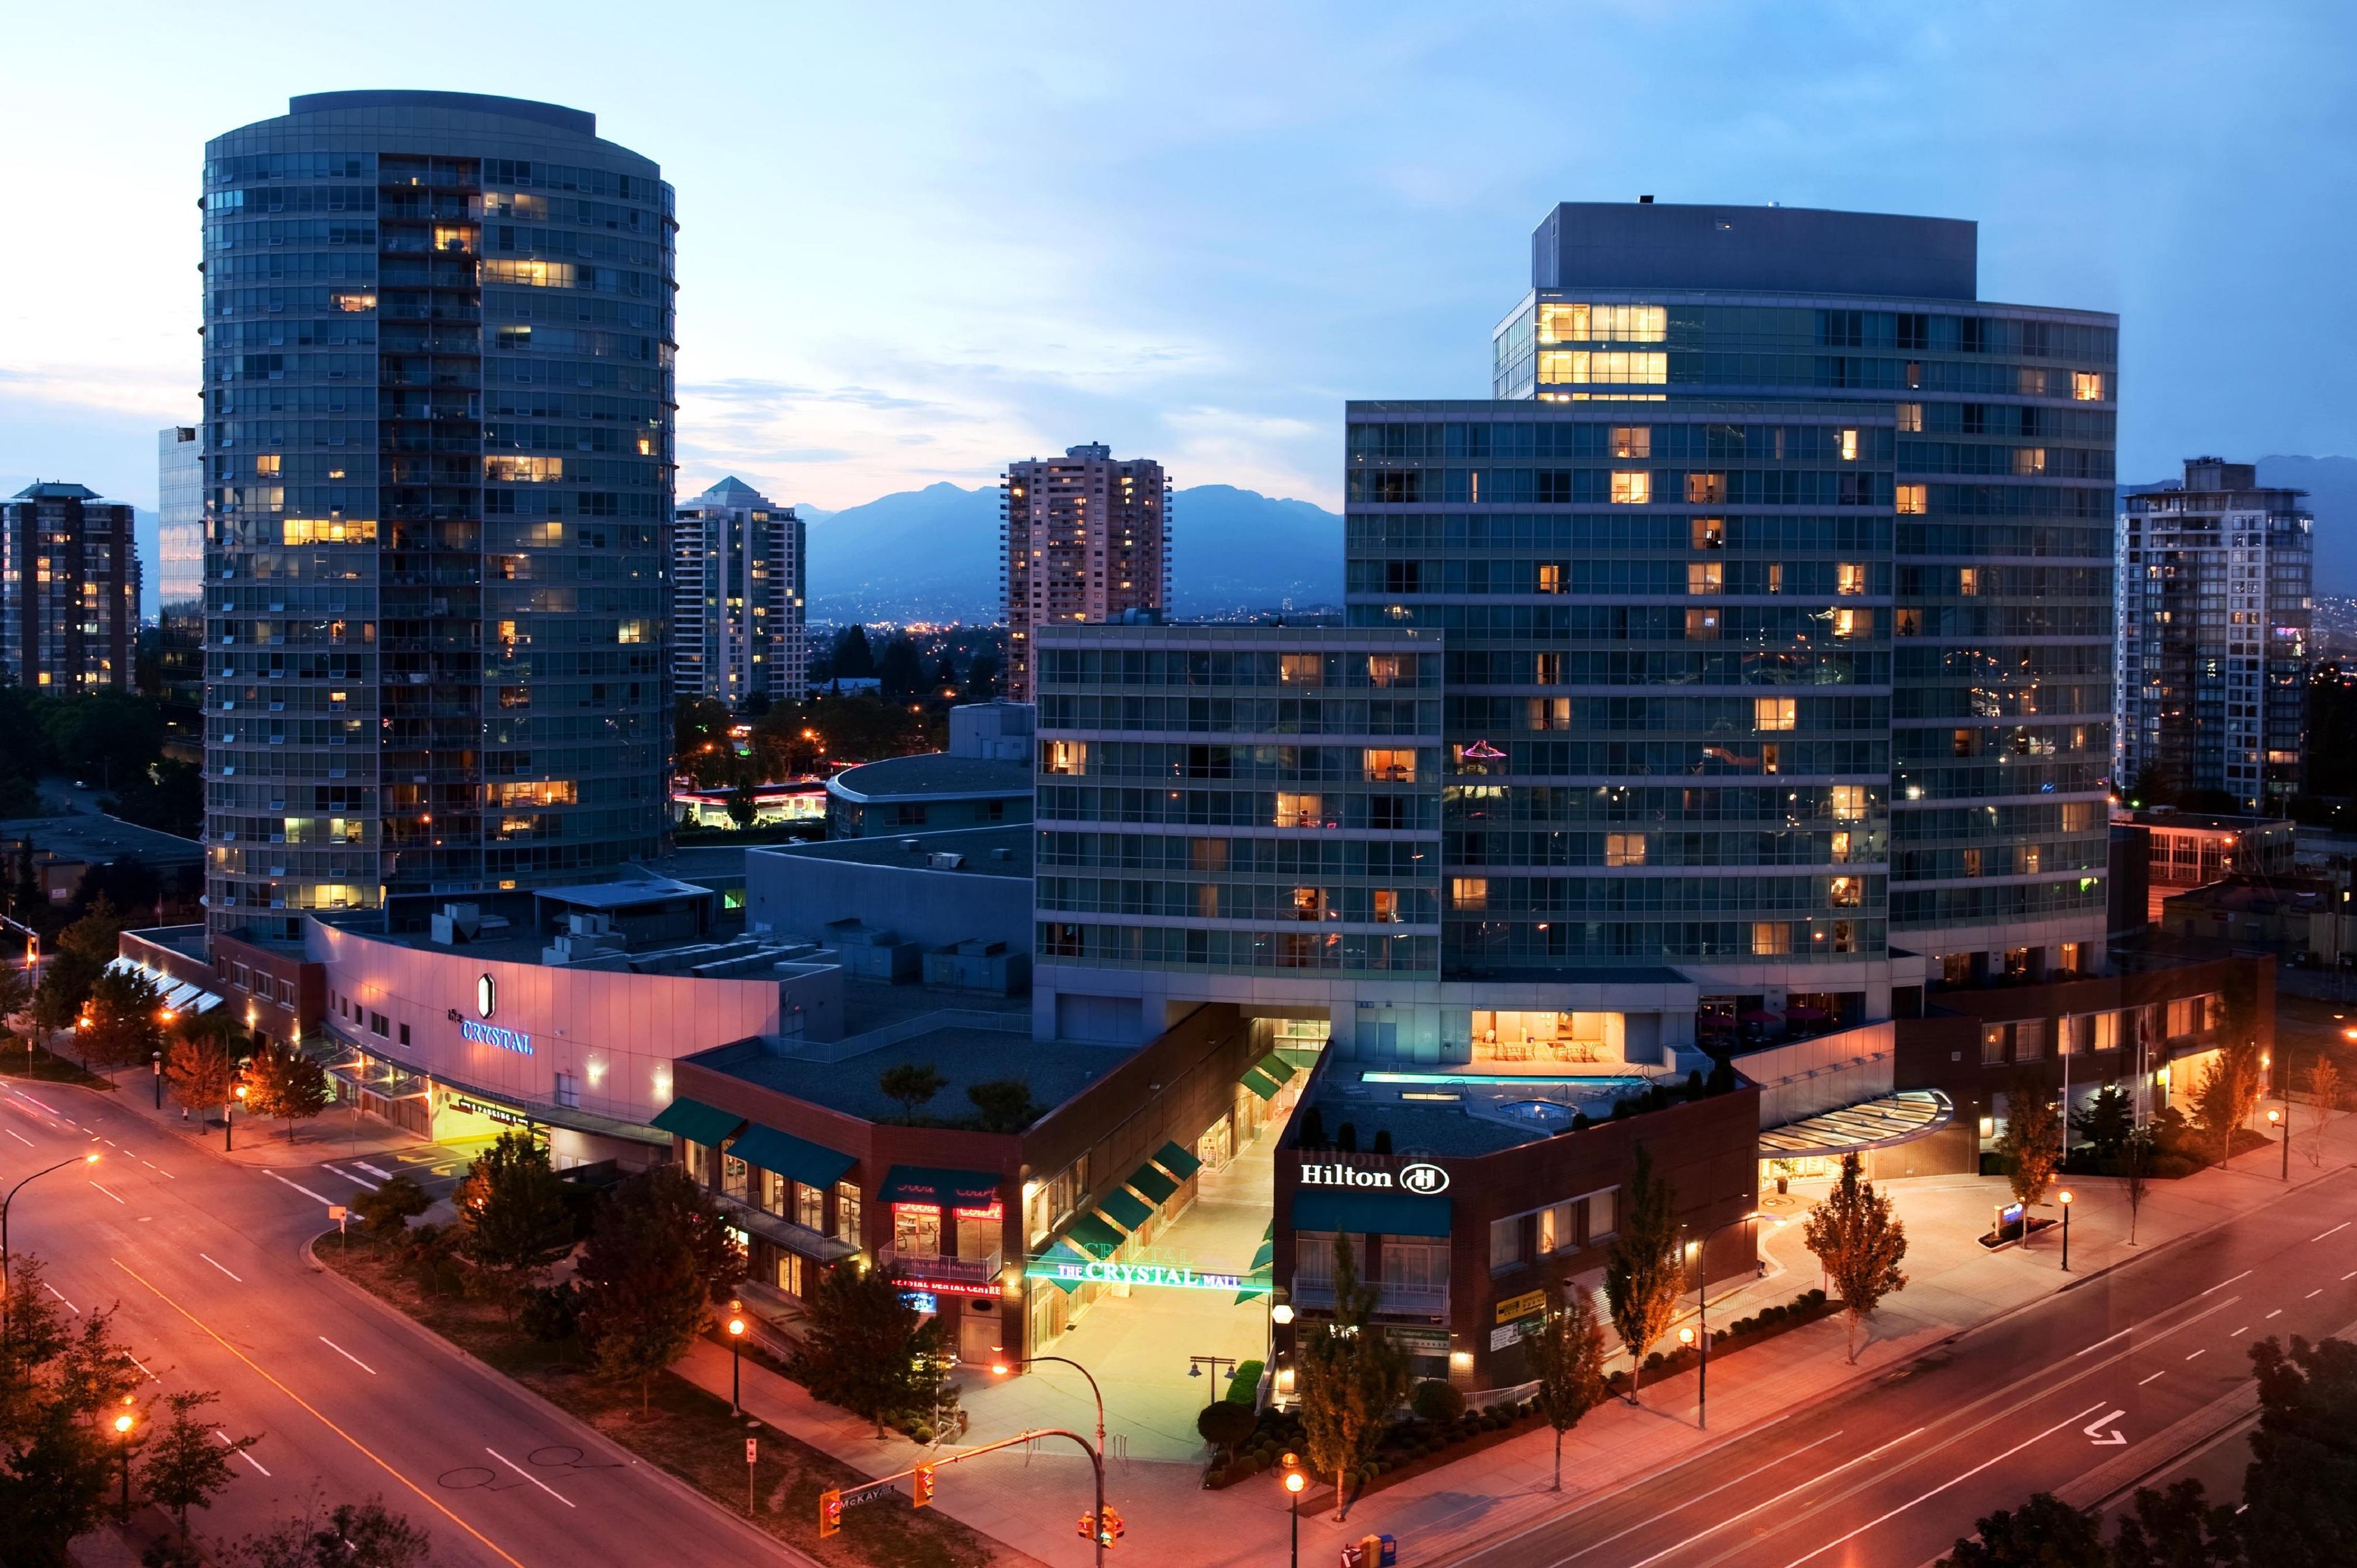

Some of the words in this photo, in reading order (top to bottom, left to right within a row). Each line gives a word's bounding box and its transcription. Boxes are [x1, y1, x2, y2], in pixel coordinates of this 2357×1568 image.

[448, 1009, 463, 1023] the
[462, 1020, 533, 1056] CRYSTAL
[478, 1106, 510, 1121] PARKING
[1301, 1163, 1393, 1187] Hilton
[1058, 1264, 1083, 1277] THE
[1085, 1260, 1198, 1285] CRYSTAL
[1202, 1274, 1241, 1288] MALL
[840, 1490, 879, 1509] McKAY
